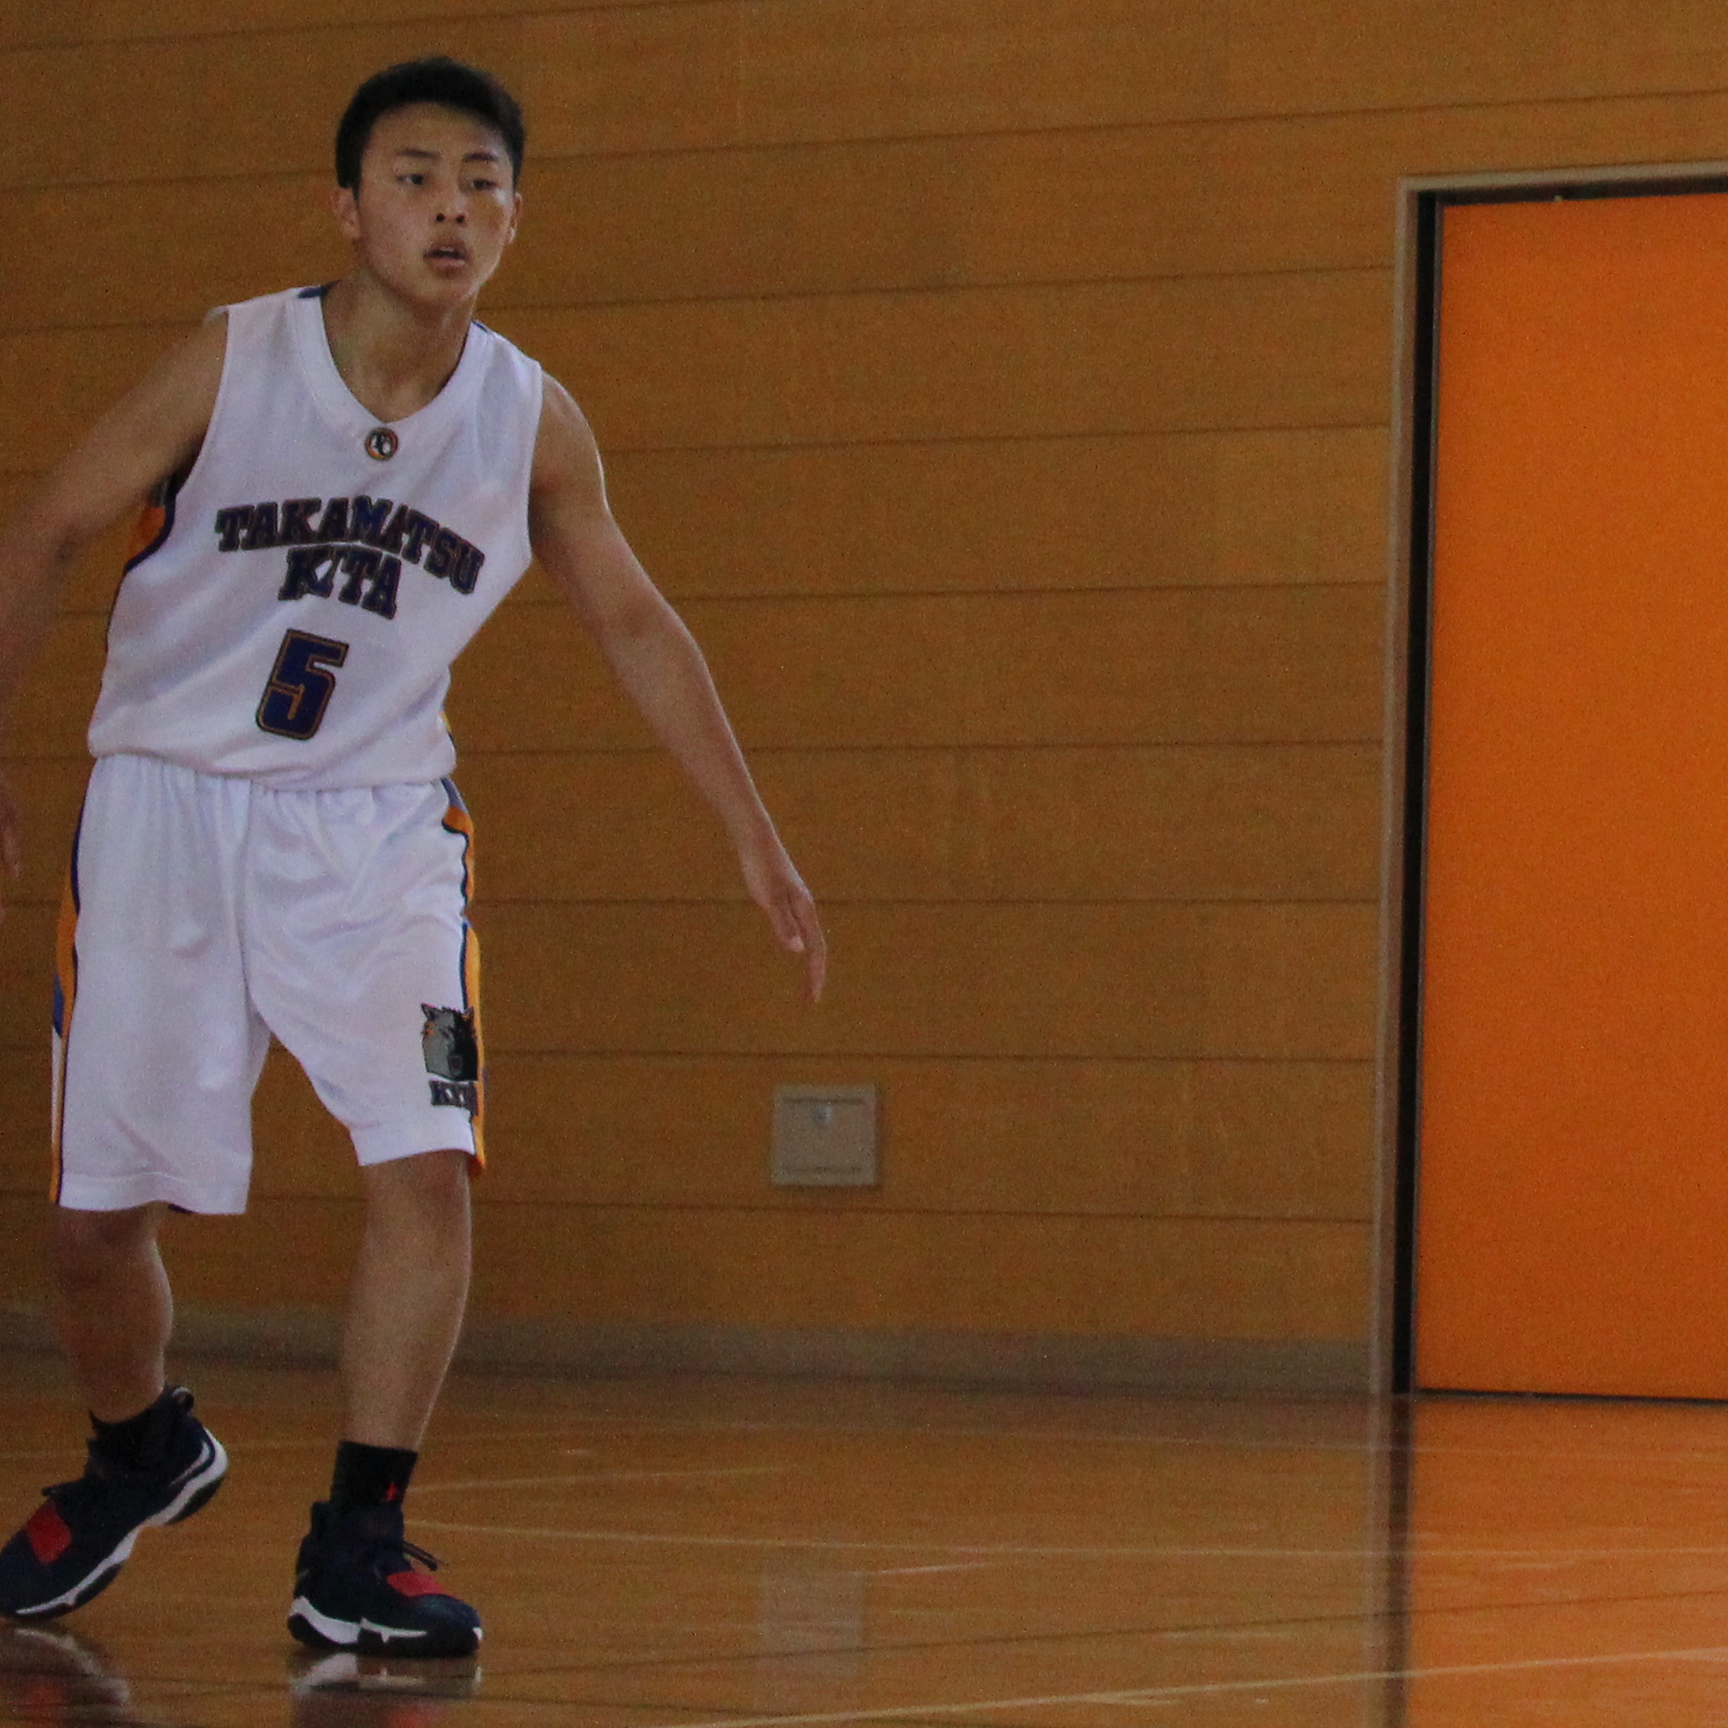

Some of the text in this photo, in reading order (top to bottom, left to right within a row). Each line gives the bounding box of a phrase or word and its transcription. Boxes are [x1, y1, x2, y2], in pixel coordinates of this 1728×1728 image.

[214, 495, 485, 595] TAKAMATSU
[277, 545, 402, 620] KITA
[255, 628, 349, 741] 5
